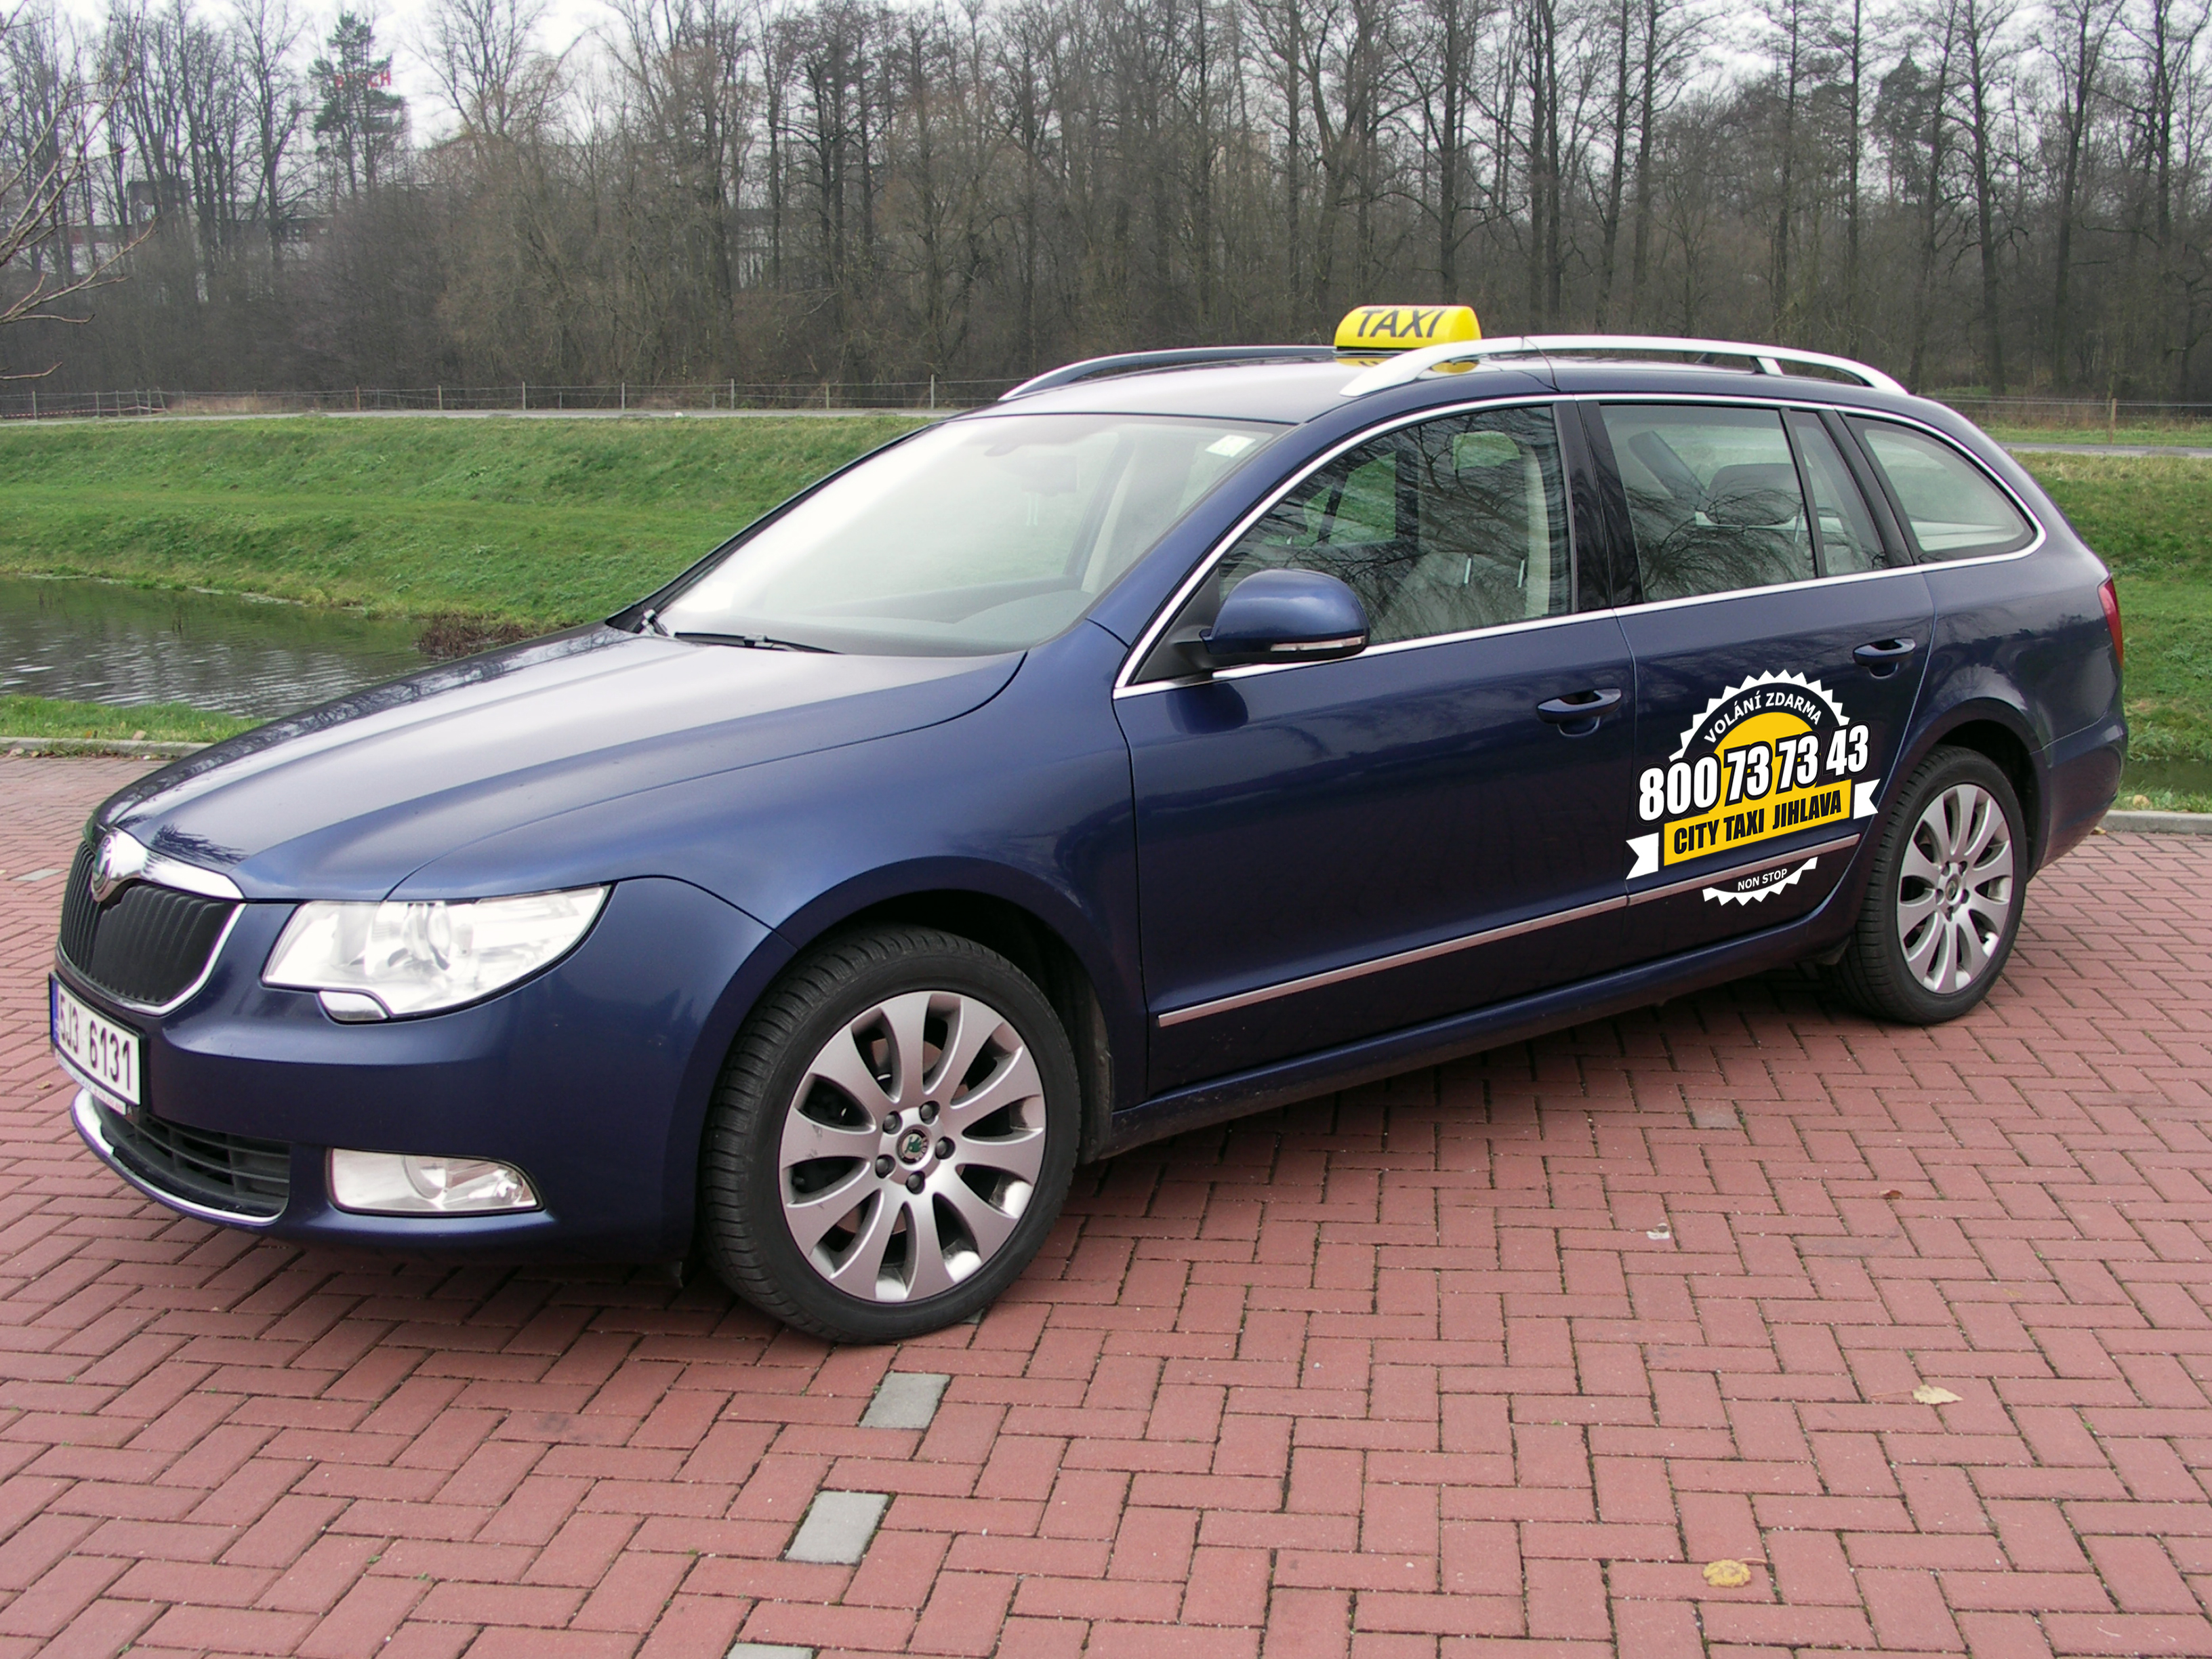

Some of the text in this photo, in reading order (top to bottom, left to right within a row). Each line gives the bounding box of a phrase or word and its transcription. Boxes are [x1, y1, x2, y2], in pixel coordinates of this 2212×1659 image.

[333, 69, 391, 89] BCH
[1357, 309, 1448, 337] TAXI
[1704, 691, 1821, 743] VOLÁNÍ ZDARMA
[1639, 724, 1868, 821] 800 73 73 43
[1674, 790, 1841, 855] CITY TAXI JIHLAVA
[1738, 868, 1787, 891] NON STOP
[89, 1019, 130, 1092] 6131
